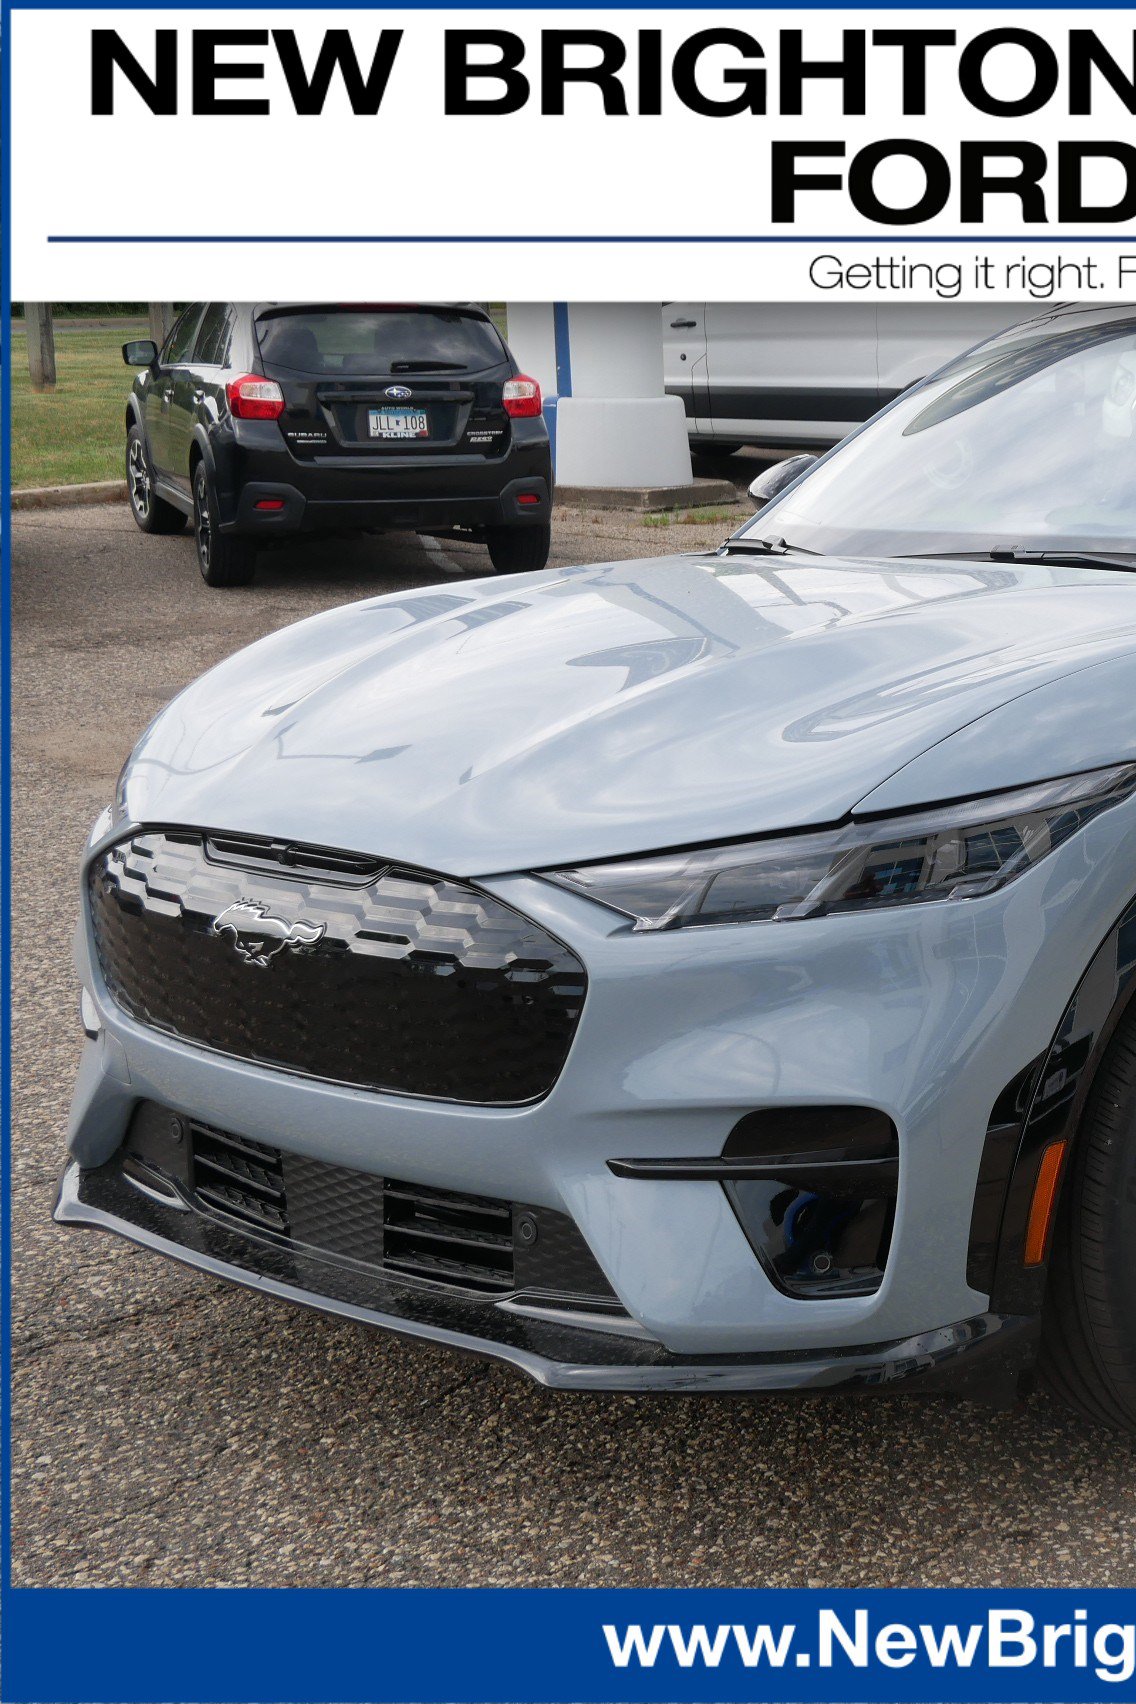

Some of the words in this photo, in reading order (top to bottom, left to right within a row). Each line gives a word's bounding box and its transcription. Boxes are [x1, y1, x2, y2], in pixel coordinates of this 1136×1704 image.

[372, 415, 394, 431] JLL
[404, 415, 426, 431] 108
[382, 431, 416, 439] KLINE
